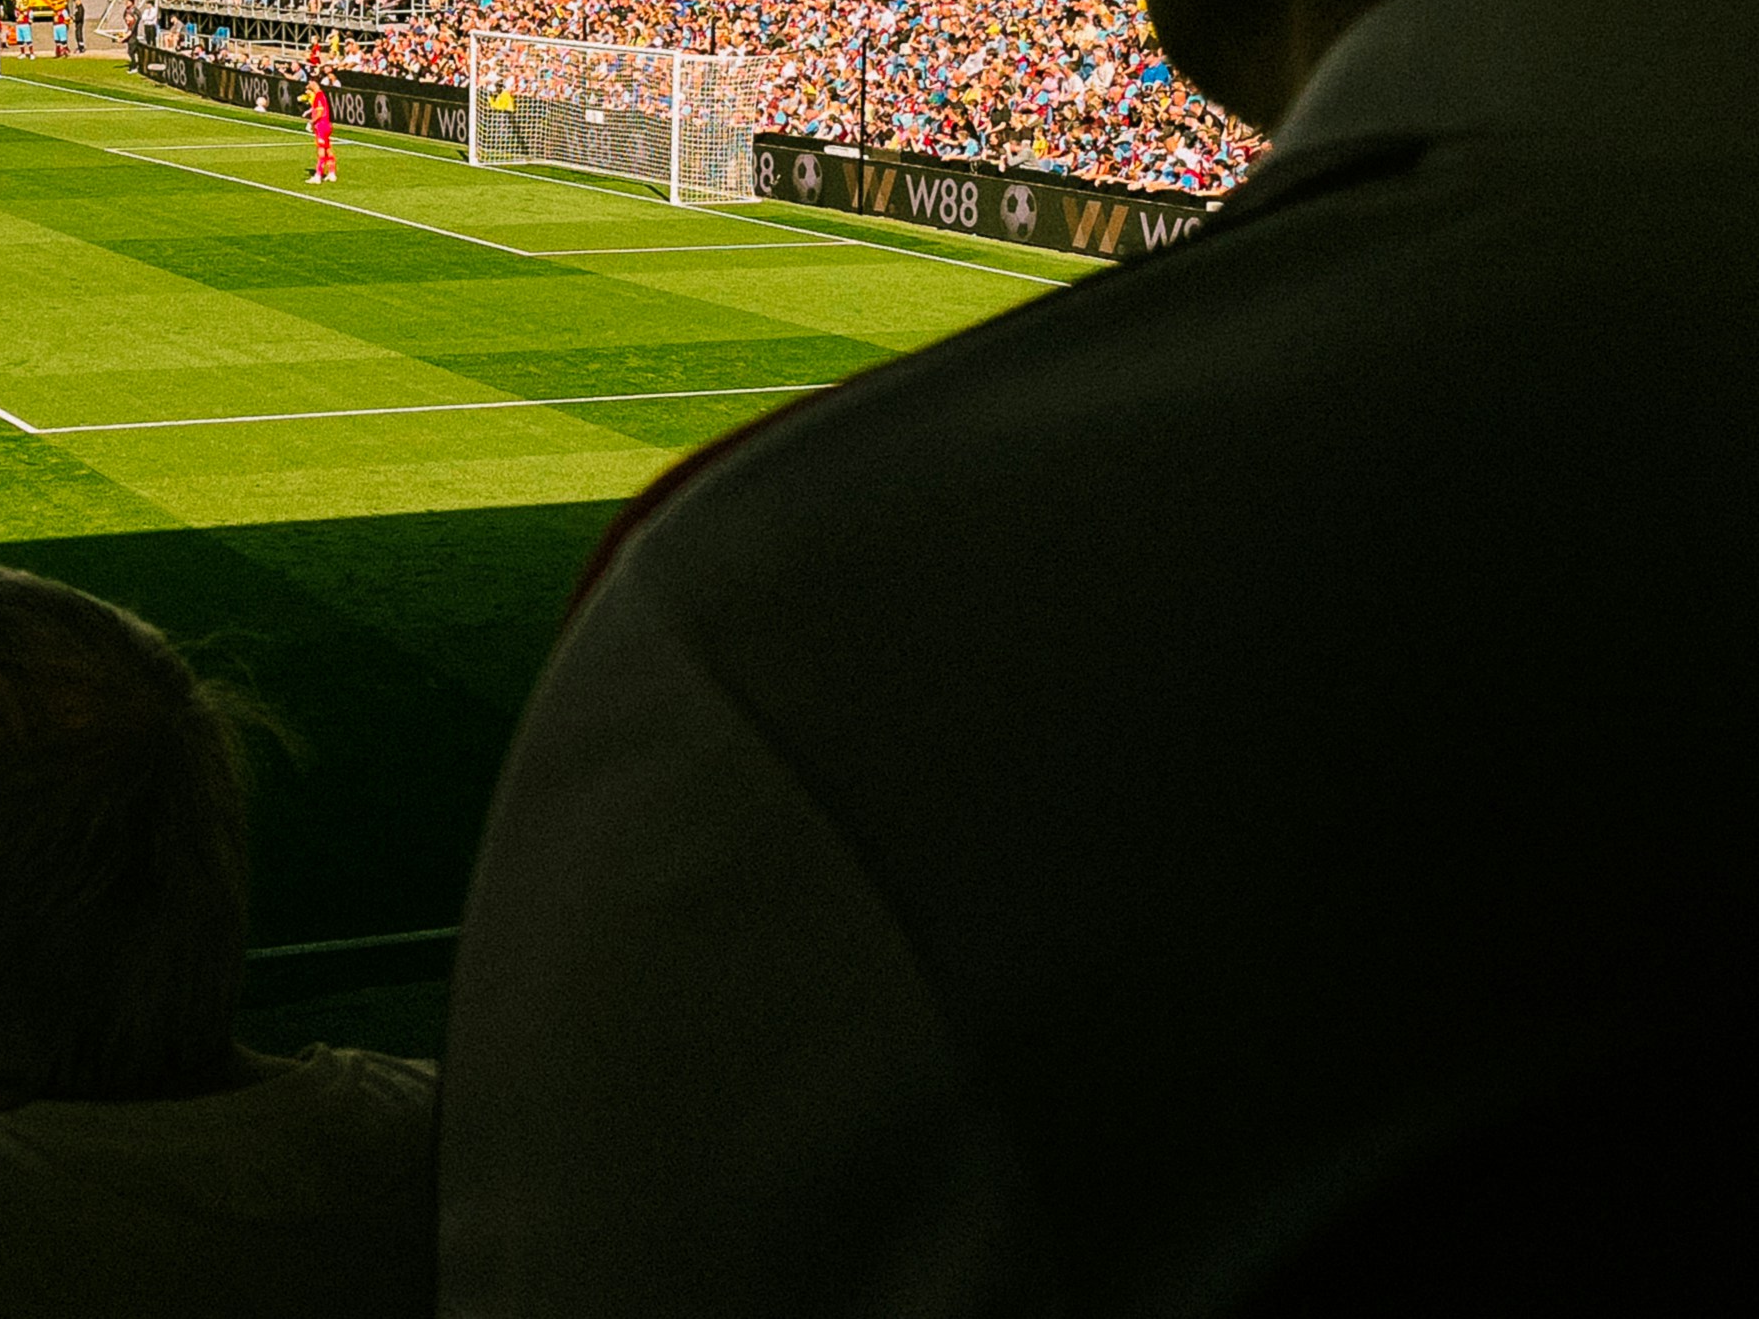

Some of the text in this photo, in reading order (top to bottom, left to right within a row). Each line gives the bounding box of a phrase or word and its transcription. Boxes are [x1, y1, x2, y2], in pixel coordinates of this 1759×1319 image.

[329, 92, 366, 126] W88
[437, 106, 468, 143] W8
[905, 174, 979, 228] W88
